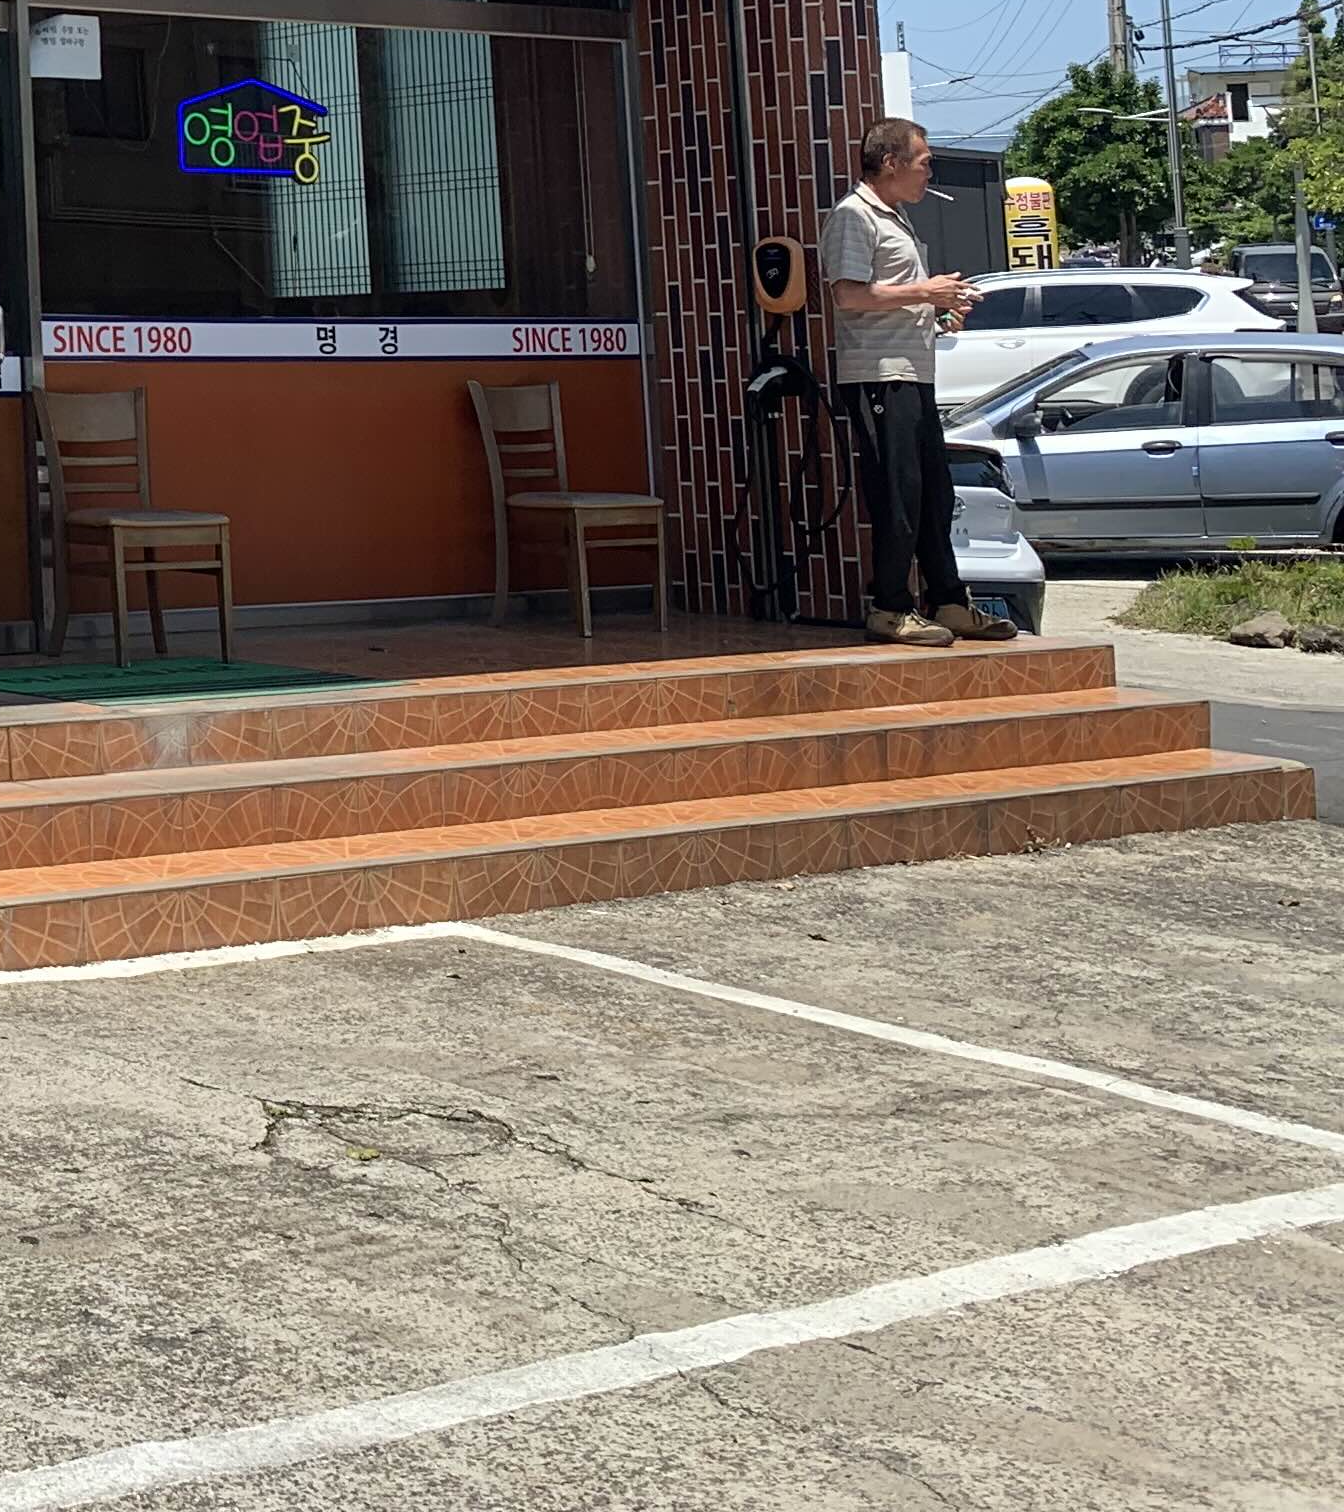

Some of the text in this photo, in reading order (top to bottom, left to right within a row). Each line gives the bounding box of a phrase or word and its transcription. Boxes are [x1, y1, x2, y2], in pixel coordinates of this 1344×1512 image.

[183, 102, 330, 184] 영업중
[53, 324, 192, 354] SINCE 1980
[512, 327, 627, 354] SINCE 1980
